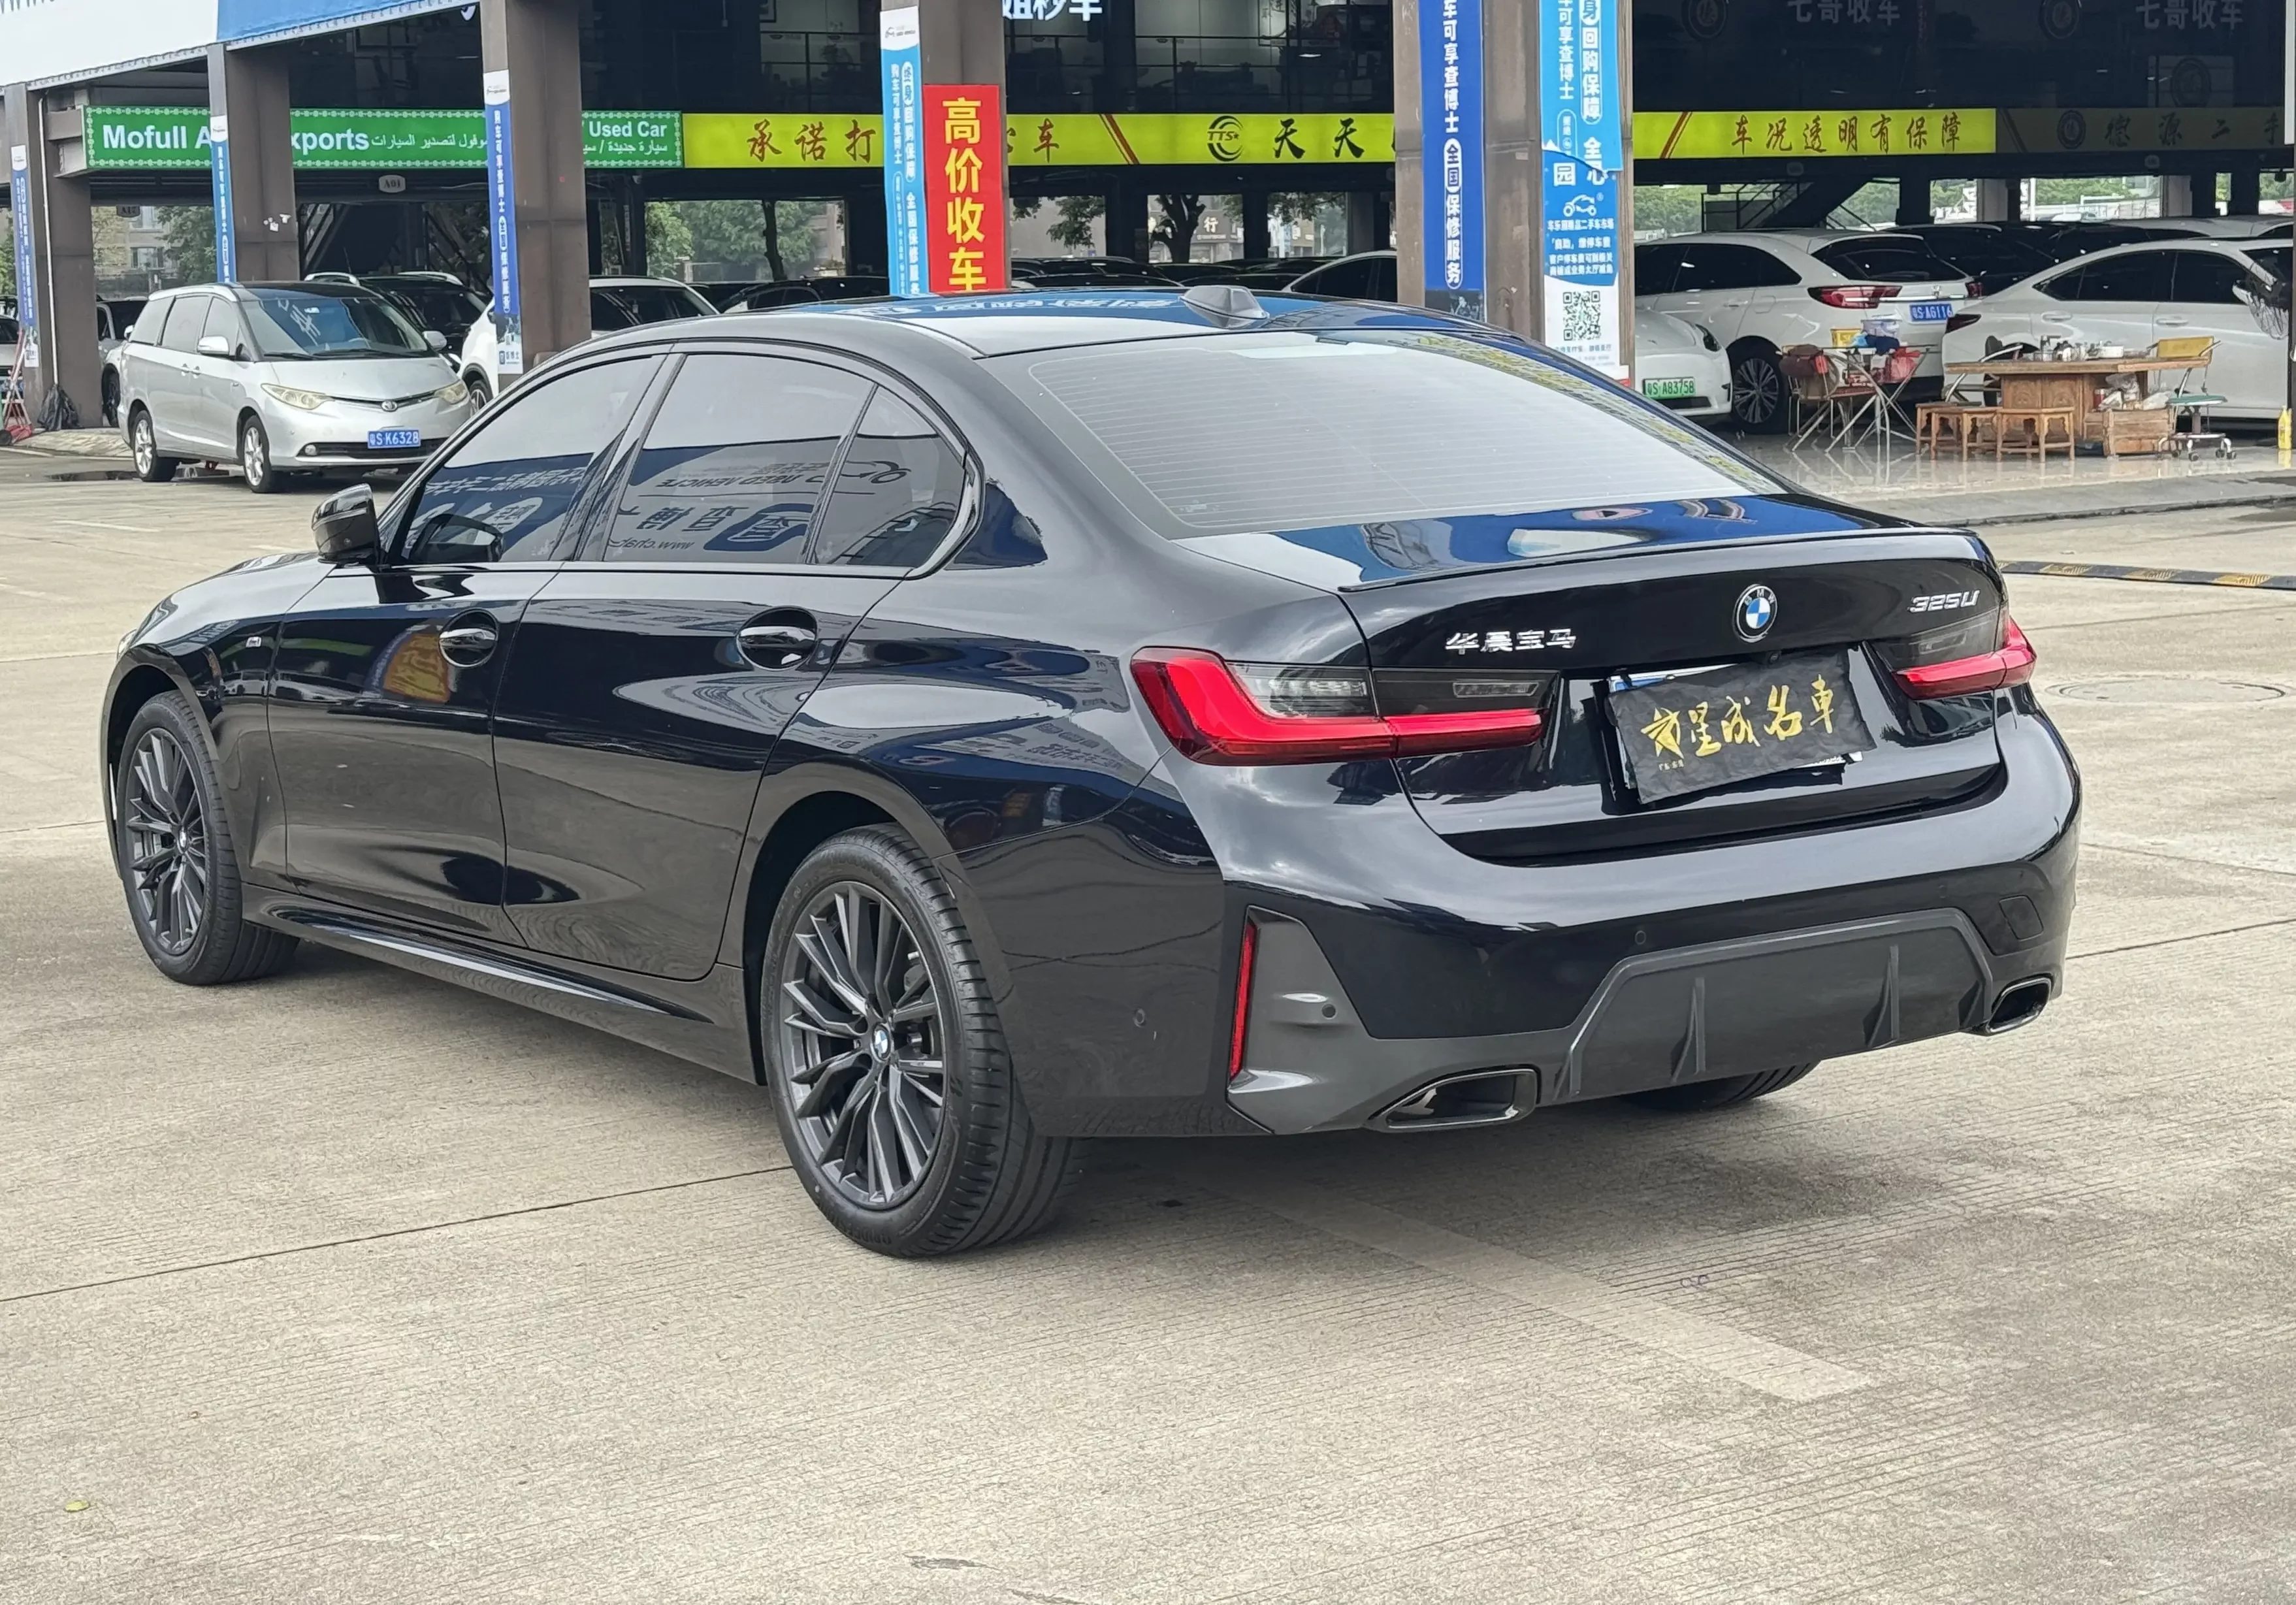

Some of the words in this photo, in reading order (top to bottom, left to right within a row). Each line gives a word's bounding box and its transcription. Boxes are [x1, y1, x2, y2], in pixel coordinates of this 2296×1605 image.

[2136, 0, 2243, 30] 七哥收车
[103, 124, 187, 149] Mofull
[589, 121, 633, 137] Used
[638, 121, 668, 137] Car
[747, 119, 876, 163] 承诺打
[1207, 131, 1233, 141] TTS
[1273, 116, 1396, 159] 天天
[1731, 113, 1962, 155] 车况透明有保障
[1554, 163, 1576, 186] 园
[942, 97, 986, 292] 高价收车
[1446, 143, 1461, 284] 全国保修服务
[1445, 629, 1576, 655] 华晨宝马
